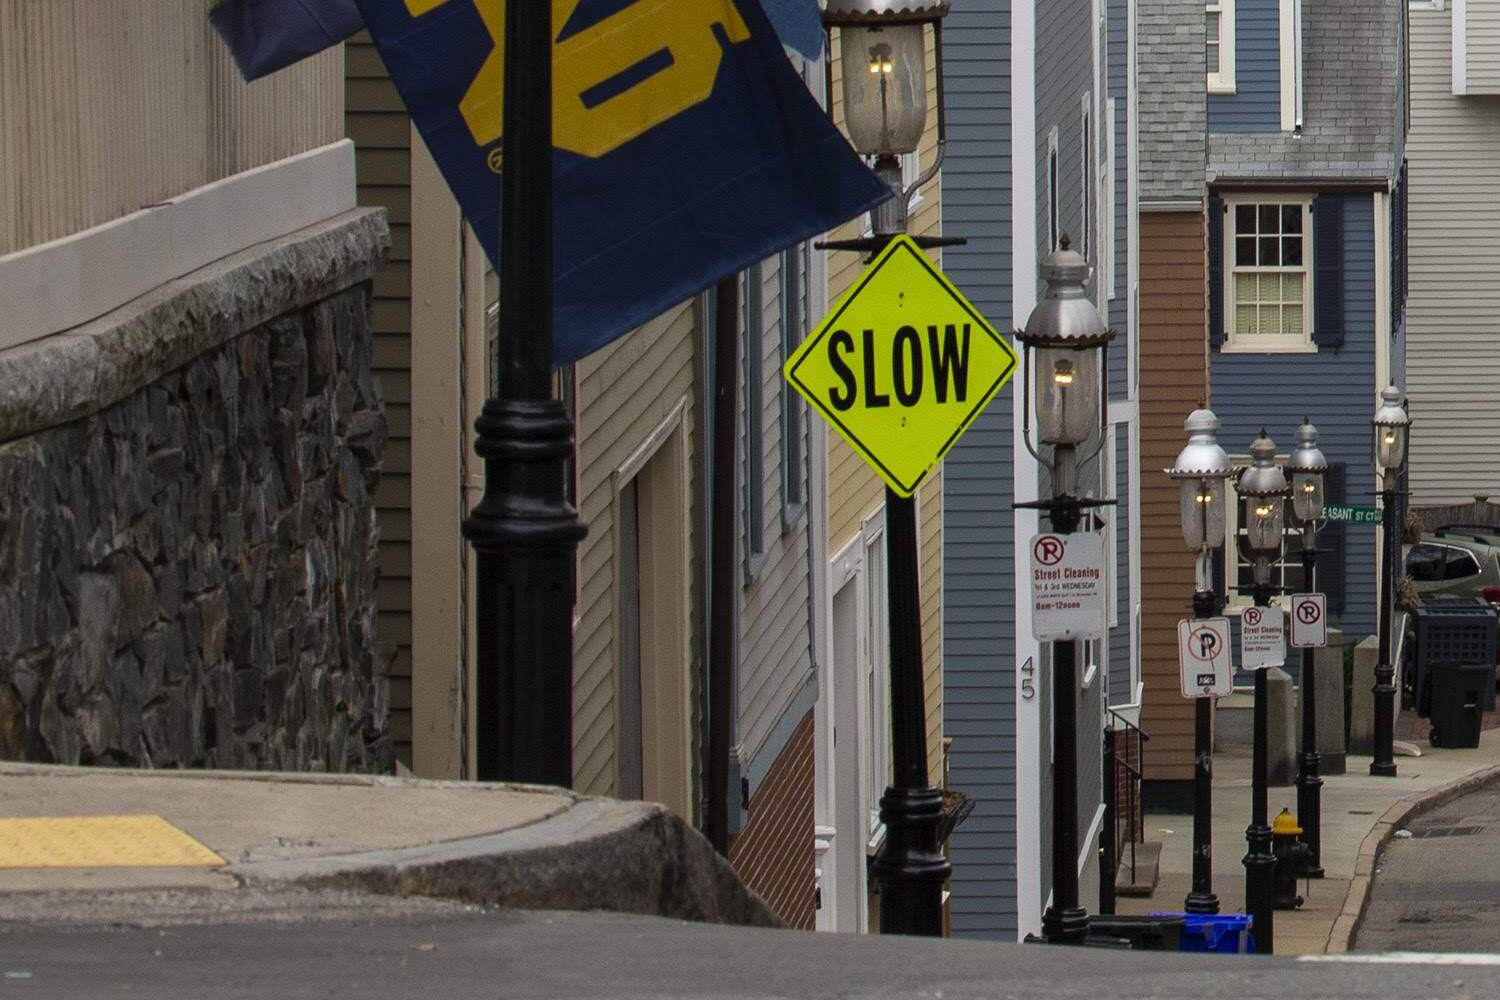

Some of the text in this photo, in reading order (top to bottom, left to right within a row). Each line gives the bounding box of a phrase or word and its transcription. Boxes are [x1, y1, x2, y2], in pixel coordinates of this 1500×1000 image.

[828, 323, 971, 411] SLOW
[1320, 507, 1354, 520] EASANT
[1034, 567, 1099, 580] Street Cleaning
